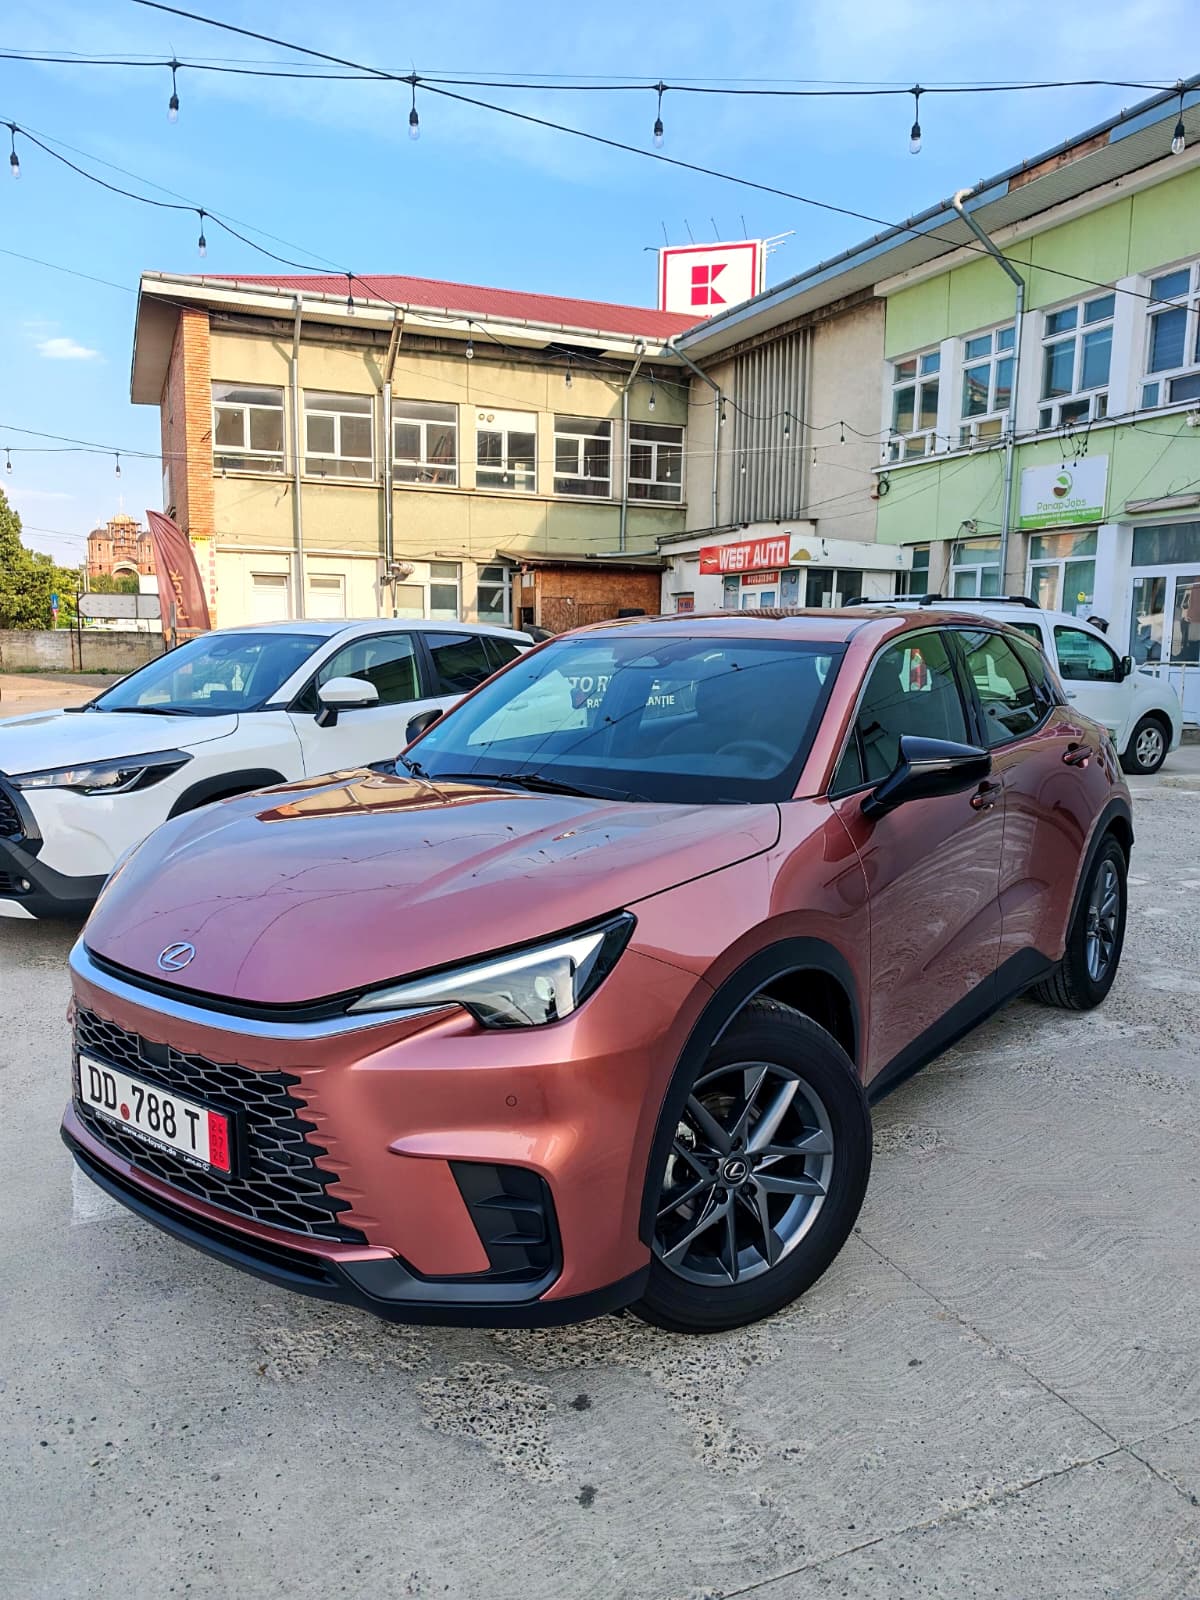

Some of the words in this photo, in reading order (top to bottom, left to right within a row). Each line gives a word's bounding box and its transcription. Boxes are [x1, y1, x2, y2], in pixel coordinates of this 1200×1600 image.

[691, 264, 728, 306] K
[719, 547, 751, 570] WEST
[752, 540, 786, 566] AUTO
[88, 1066, 117, 1110] DD
[131, 1085, 177, 1139] 788
[184, 1108, 200, 1150] T
